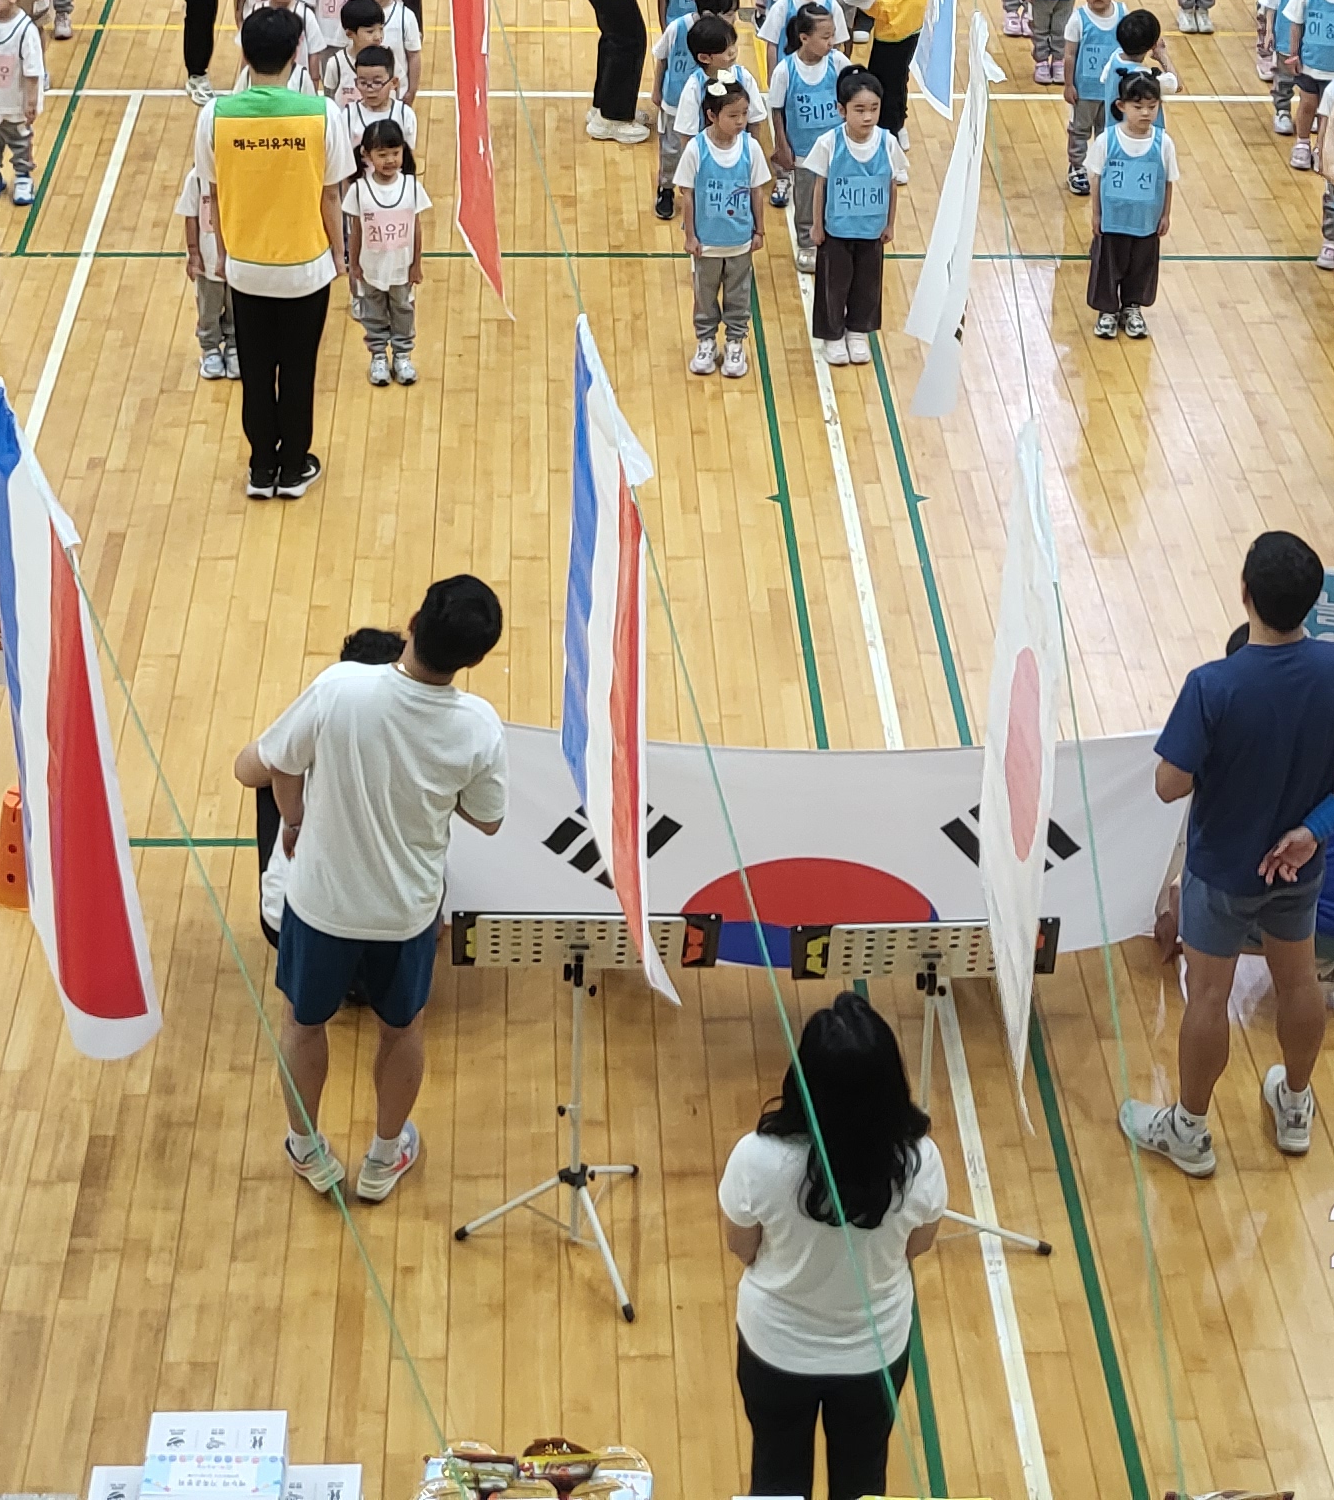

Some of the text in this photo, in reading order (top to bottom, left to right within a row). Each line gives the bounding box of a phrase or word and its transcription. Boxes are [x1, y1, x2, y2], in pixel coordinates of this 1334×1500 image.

[233, 137, 306, 151] 해누리유치원
[1112, 170, 1152, 190] 김 선
[838, 187, 884, 210] 석다혜
[367, 223, 409, 243] 최유리
